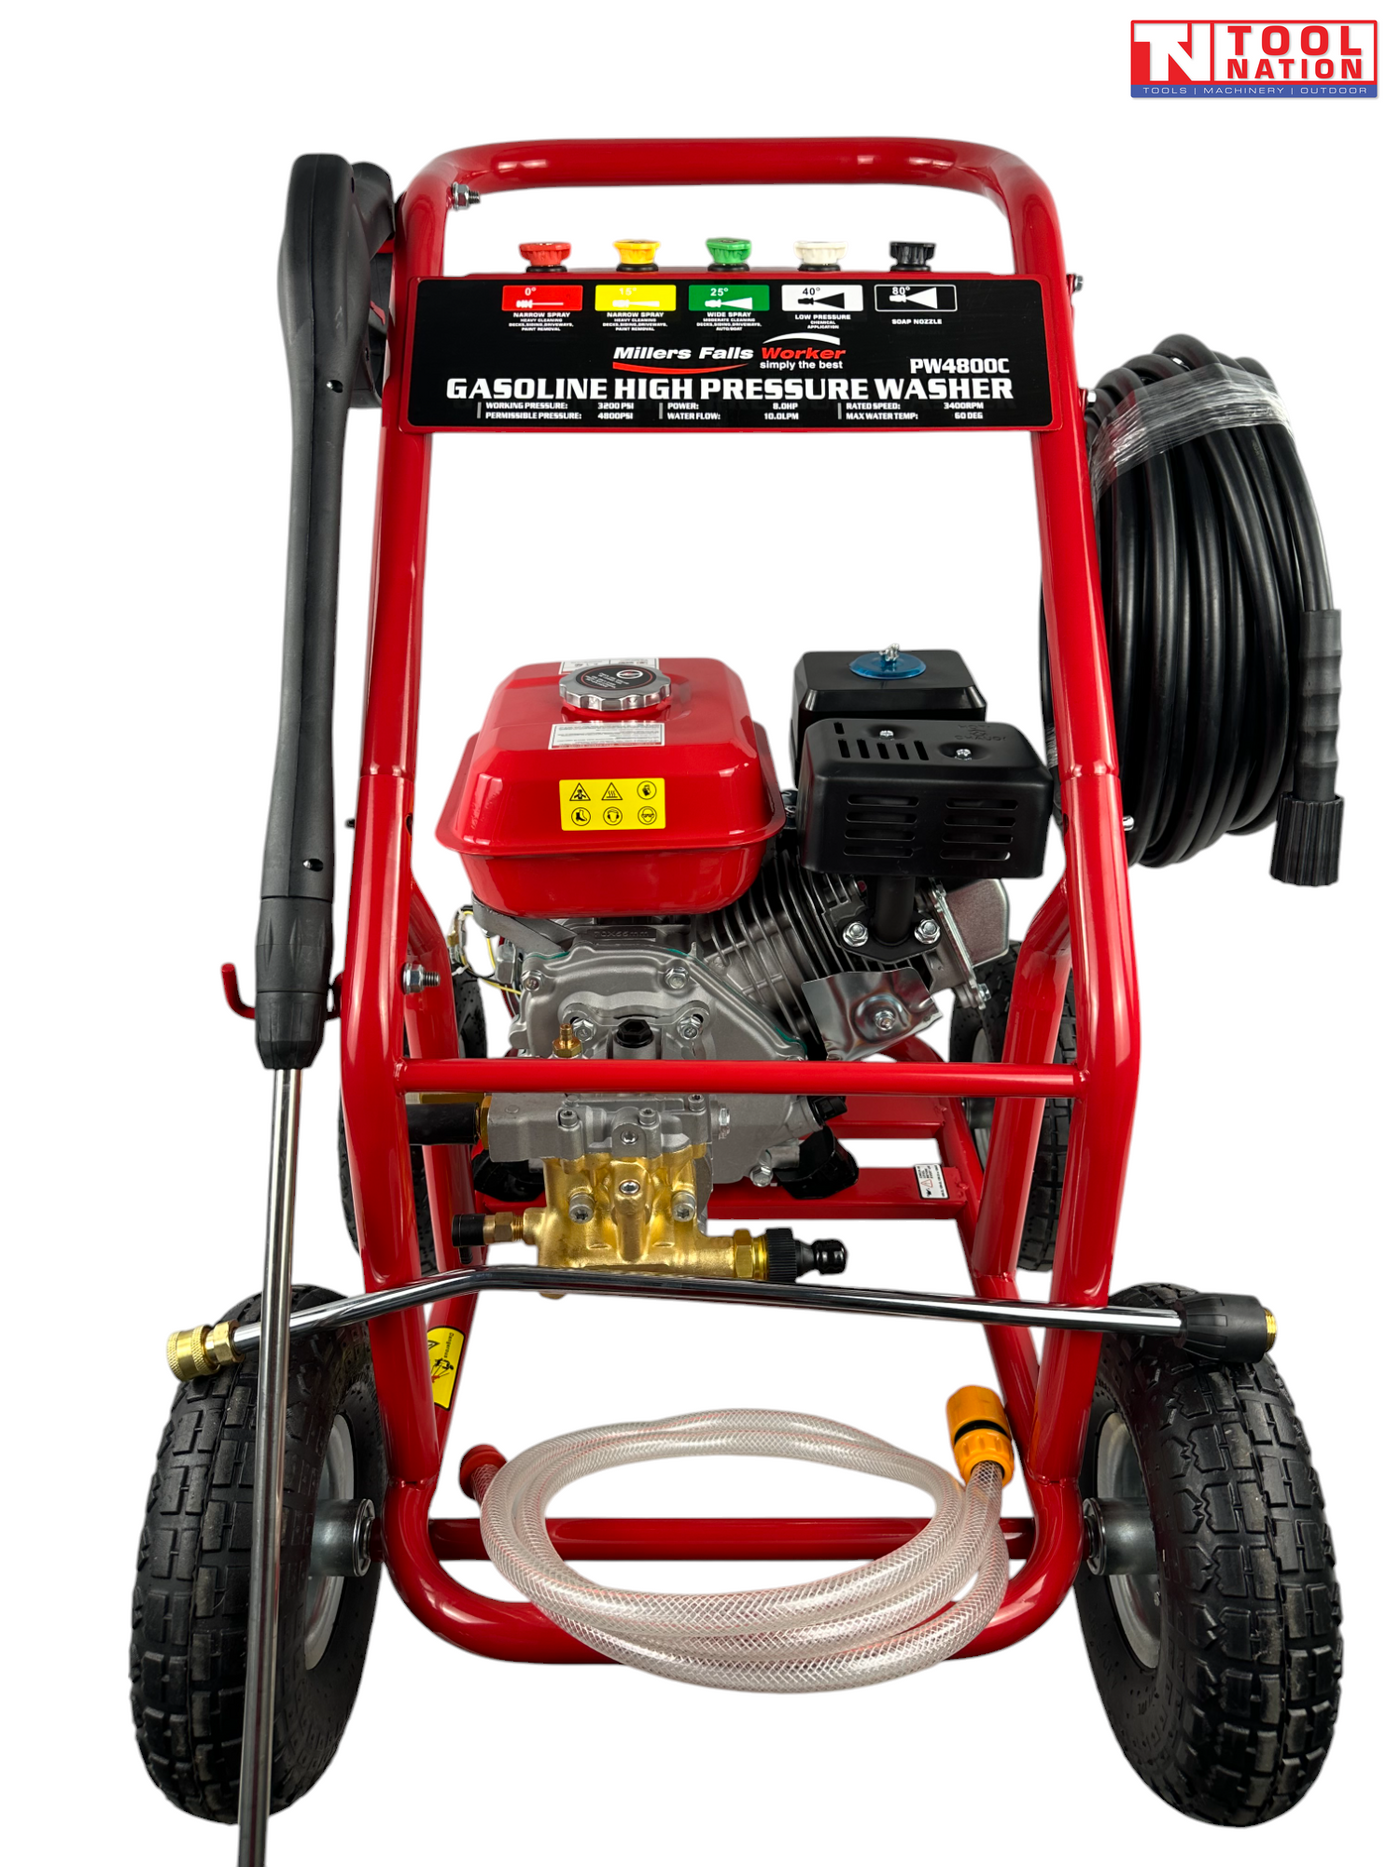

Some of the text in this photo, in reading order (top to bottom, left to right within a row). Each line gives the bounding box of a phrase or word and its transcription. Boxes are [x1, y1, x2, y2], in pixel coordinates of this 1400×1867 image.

[710, 287, 729, 297] 25°
[802, 287, 821, 296] 40°
[613, 346, 846, 360] Millers Falls Worker
[759, 360, 843, 371] simply the best
[910, 358, 1010, 374] PW4800C
[446, 378, 1014, 400] GASOLINE HIGH PRESSURE WASHER
[485, 402, 568, 410] WORKING PRESSURE:
[597, 402, 635, 410] 3200 PSI
[667, 402, 699, 410] POWER:
[772, 402, 798, 410] 8.0HP
[846, 402, 901, 410] RATED SPEED:
[943, 402, 984, 410] 3400RPM
[485, 412, 582, 420] PERMISSIBLE PRESSURE:
[597, 412, 634, 420] 4800PSI
[667, 412, 721, 420] WATER FLOW:
[764, 412, 799, 420] 10.0LPM
[846, 412, 919, 420] MAX WATER TEMP:
[443, 1332, 455, 1358] Dangerous
